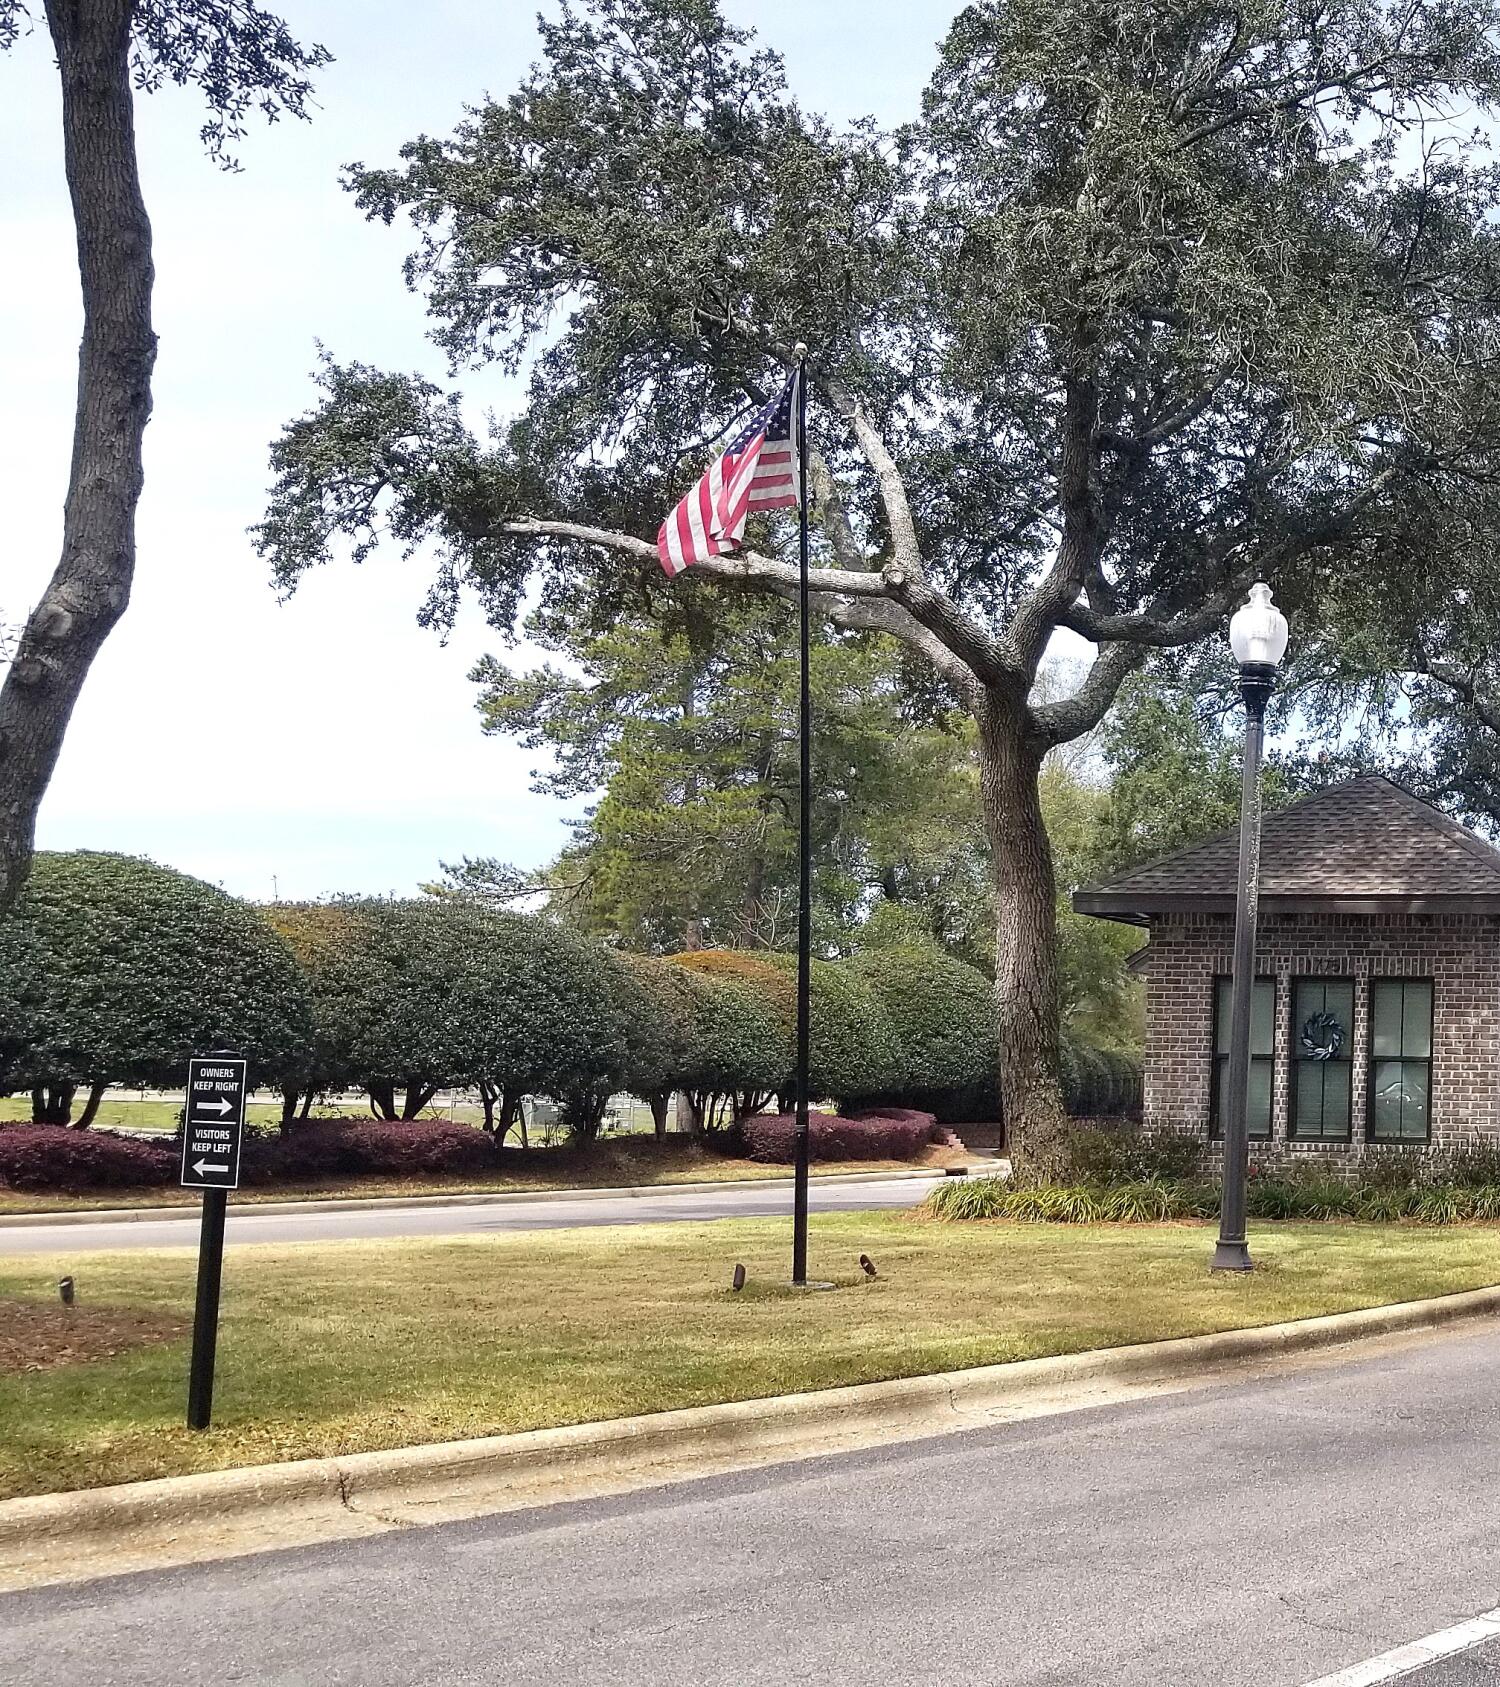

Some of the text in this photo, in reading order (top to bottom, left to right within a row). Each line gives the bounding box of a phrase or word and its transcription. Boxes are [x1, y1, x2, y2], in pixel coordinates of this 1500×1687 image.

[200, 1068, 234, 1077] OWNERS
[193, 1081, 239, 1091] KEEP RIGHT
[195, 1129, 230, 1139] VISITORS
[192, 1142, 232, 1153] KEEP LEFT
